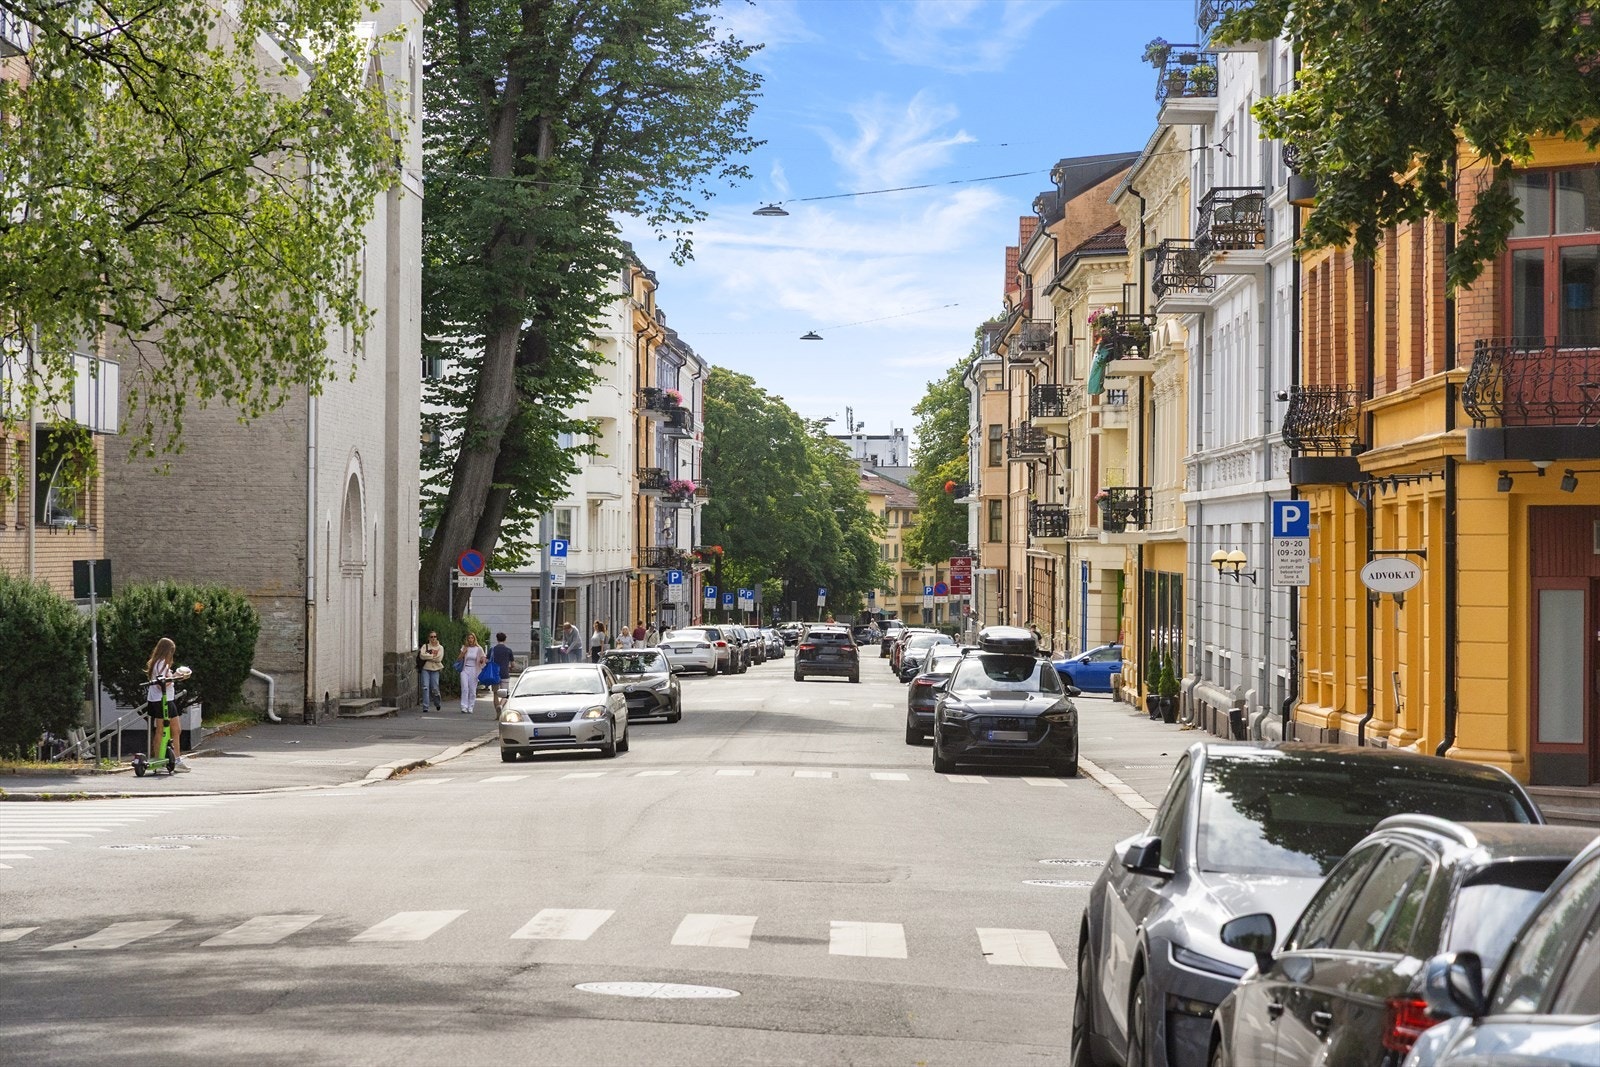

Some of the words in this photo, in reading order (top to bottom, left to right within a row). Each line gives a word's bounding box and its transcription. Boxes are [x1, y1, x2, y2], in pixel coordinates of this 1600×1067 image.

[1282, 505, 1301, 533] P
[554, 541, 564, 555] P
[1277, 549, 1306, 557] (09-20)
[671, 572, 679, 583] P
[1368, 570, 1416, 580] ADVOKAT
[707, 587, 714, 597] P
[740, 589, 746, 597] P
[746, 591, 752, 599] P
[926, 587, 932, 595] P
[725, 594, 732, 603] P
